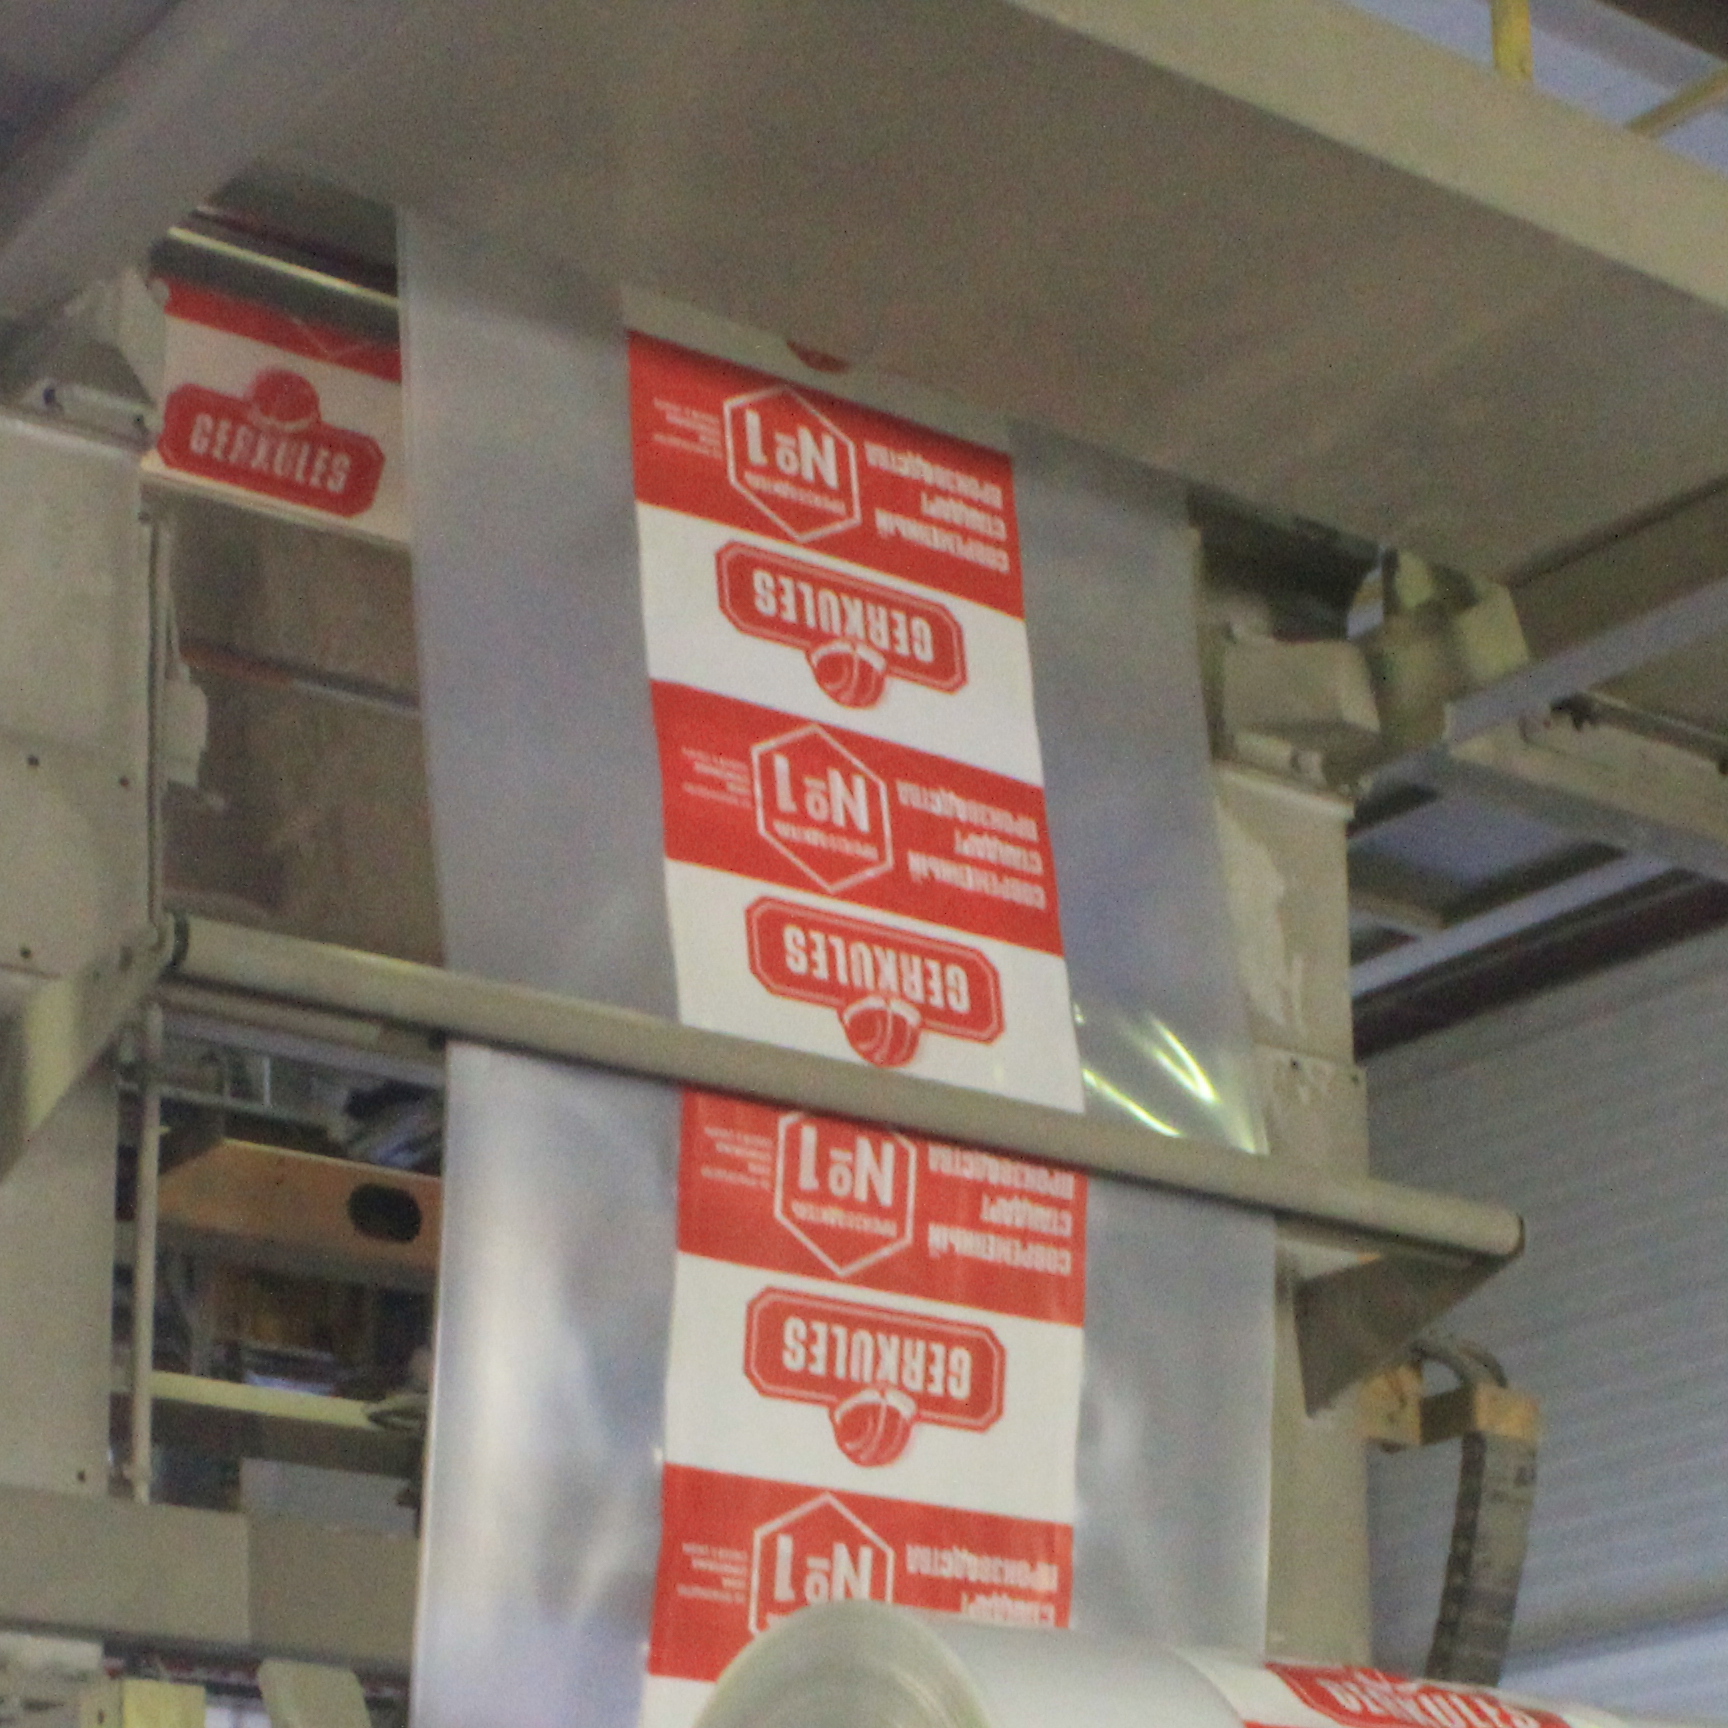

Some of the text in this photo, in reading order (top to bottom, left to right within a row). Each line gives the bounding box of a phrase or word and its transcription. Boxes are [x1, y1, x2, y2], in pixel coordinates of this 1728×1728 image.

[189, 411, 353, 495] GERKULES
[753, 568, 931, 664] GERKULES
[785, 923, 969, 1012] GERKULES
[783, 1316, 971, 1399] GERKULES
